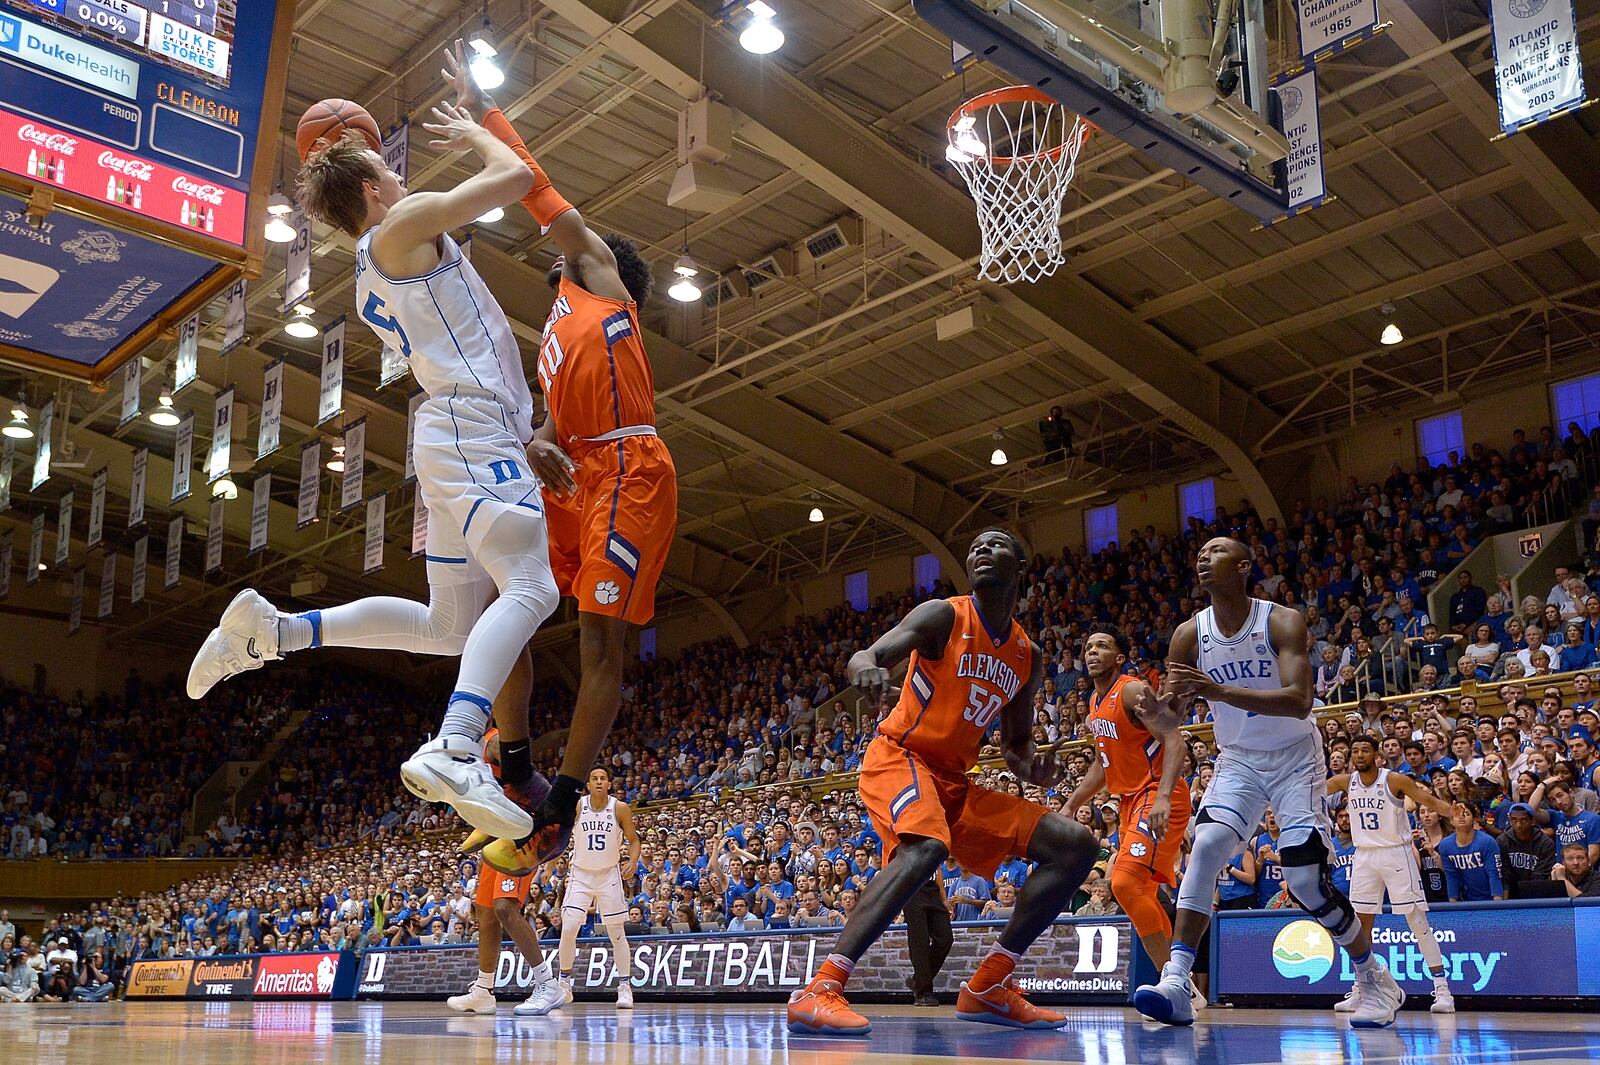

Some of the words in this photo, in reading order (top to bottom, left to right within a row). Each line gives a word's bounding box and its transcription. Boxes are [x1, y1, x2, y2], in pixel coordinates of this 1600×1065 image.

[79, 4, 126, 34] 0.0%
[195, 14, 201, 26] 1
[1310, 9, 1337, 28] REGULAR
[1322, 16, 1352, 37] 1965
[163, 34, 216, 58] UNIVERSITY
[164, 22, 216, 53] DUKE
[1508, 20, 1558, 49] ATLANTIC
[1517, 34, 1551, 58] COAST
[27, 34, 130, 84] DukeHealth
[162, 41, 214, 68] STORES
[1522, 73, 1561, 95] OURNAMENT
[157, 82, 240, 127] CLEMSON
[1528, 90, 1555, 109] 2003
[104, 103, 138, 123] PERIOD
[18, 123, 78, 156] Coca-Cola
[98, 151, 156, 182] Coca-Cola
[1288, 156, 1316, 174] PIONS
[172, 176, 226, 206] Coca-Cola
[1290, 186, 1304, 199] 02
[182, 315, 196, 344] 25
[362, 290, 412, 358] 5
[488, 460, 522, 484] D
[1522, 540, 1539, 555] 14
[1396, 588, 1410, 600] UKE
[957, 653, 1020, 702] CLEMSON
[1208, 660, 1272, 684] DUKE
[964, 683, 1002, 728] 50
[1352, 798, 1385, 810] DUKE
[581, 820, 614, 832] DUKE
[1358, 812, 1380, 830] 13
[588, 834, 606, 850] 15
[1264, 865, 1282, 880] 15
[1448, 852, 1484, 870] DUKE
[1429, 872, 1442, 890] 5
[1073, 926, 1119, 972] D
[135, 964, 180, 986] Continental
[194, 960, 245, 986] Continental
[364, 953, 386, 982] D
[494, 950, 580, 988] DUK
[586, 940, 816, 988] BASKETBALL
[145, 985, 168, 994] TIRE
[206, 984, 234, 994] TIRE
[254, 967, 314, 994] Ameritas
[1018, 977, 1122, 992] #HereComesDuke
